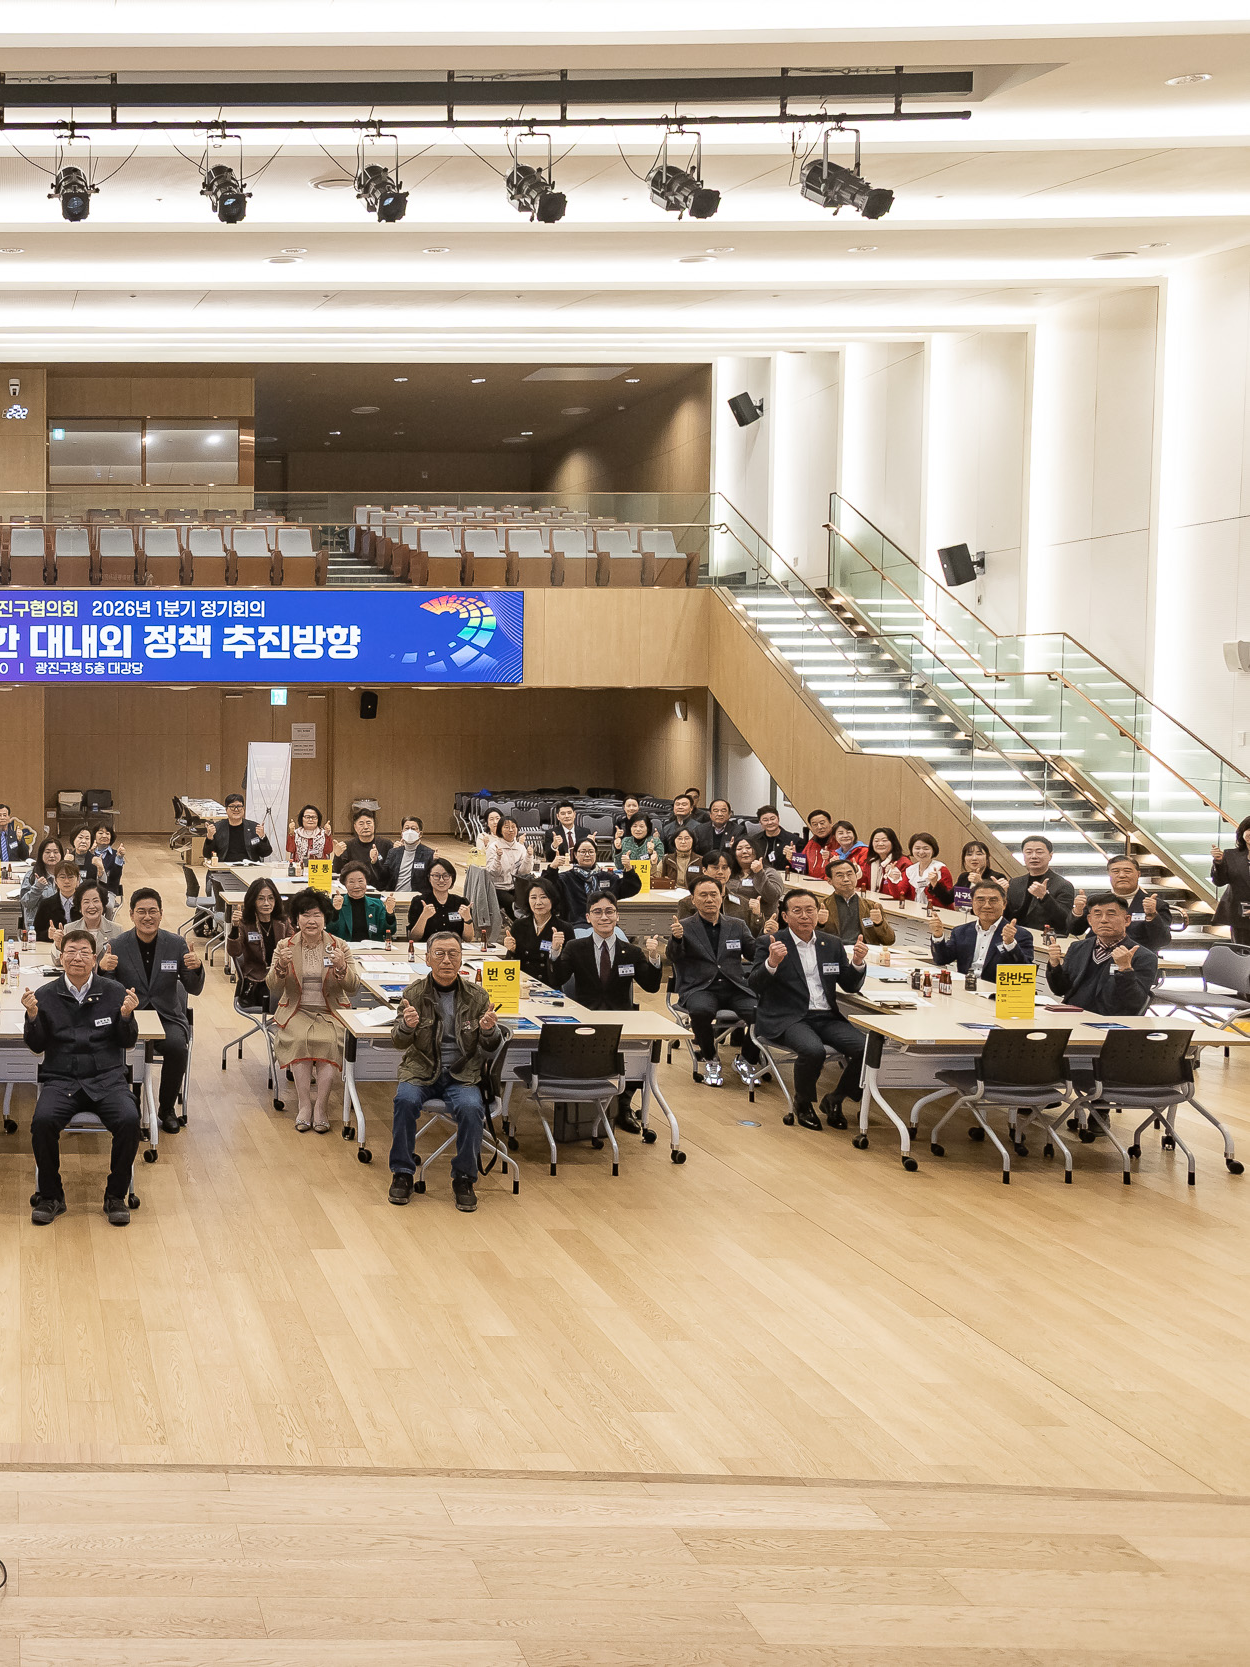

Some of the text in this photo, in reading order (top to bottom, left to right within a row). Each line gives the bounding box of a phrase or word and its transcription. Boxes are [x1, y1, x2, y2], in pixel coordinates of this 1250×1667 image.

[92, 600, 150, 617] 2026년
[156, 600, 195, 617] 1분기
[201, 600, 264, 617] 정기회의
[30, 625, 131, 659] 대내외
[143, 625, 211, 659] 정책
[222, 624, 361, 660] 추진방향
[35, 661, 83, 675] 광진구청
[84, 661, 105, 675] 5층
[107, 661, 144, 675] 대강당
[487, 967, 516, 982] 번영
[998, 972, 1034, 986] 한반도
